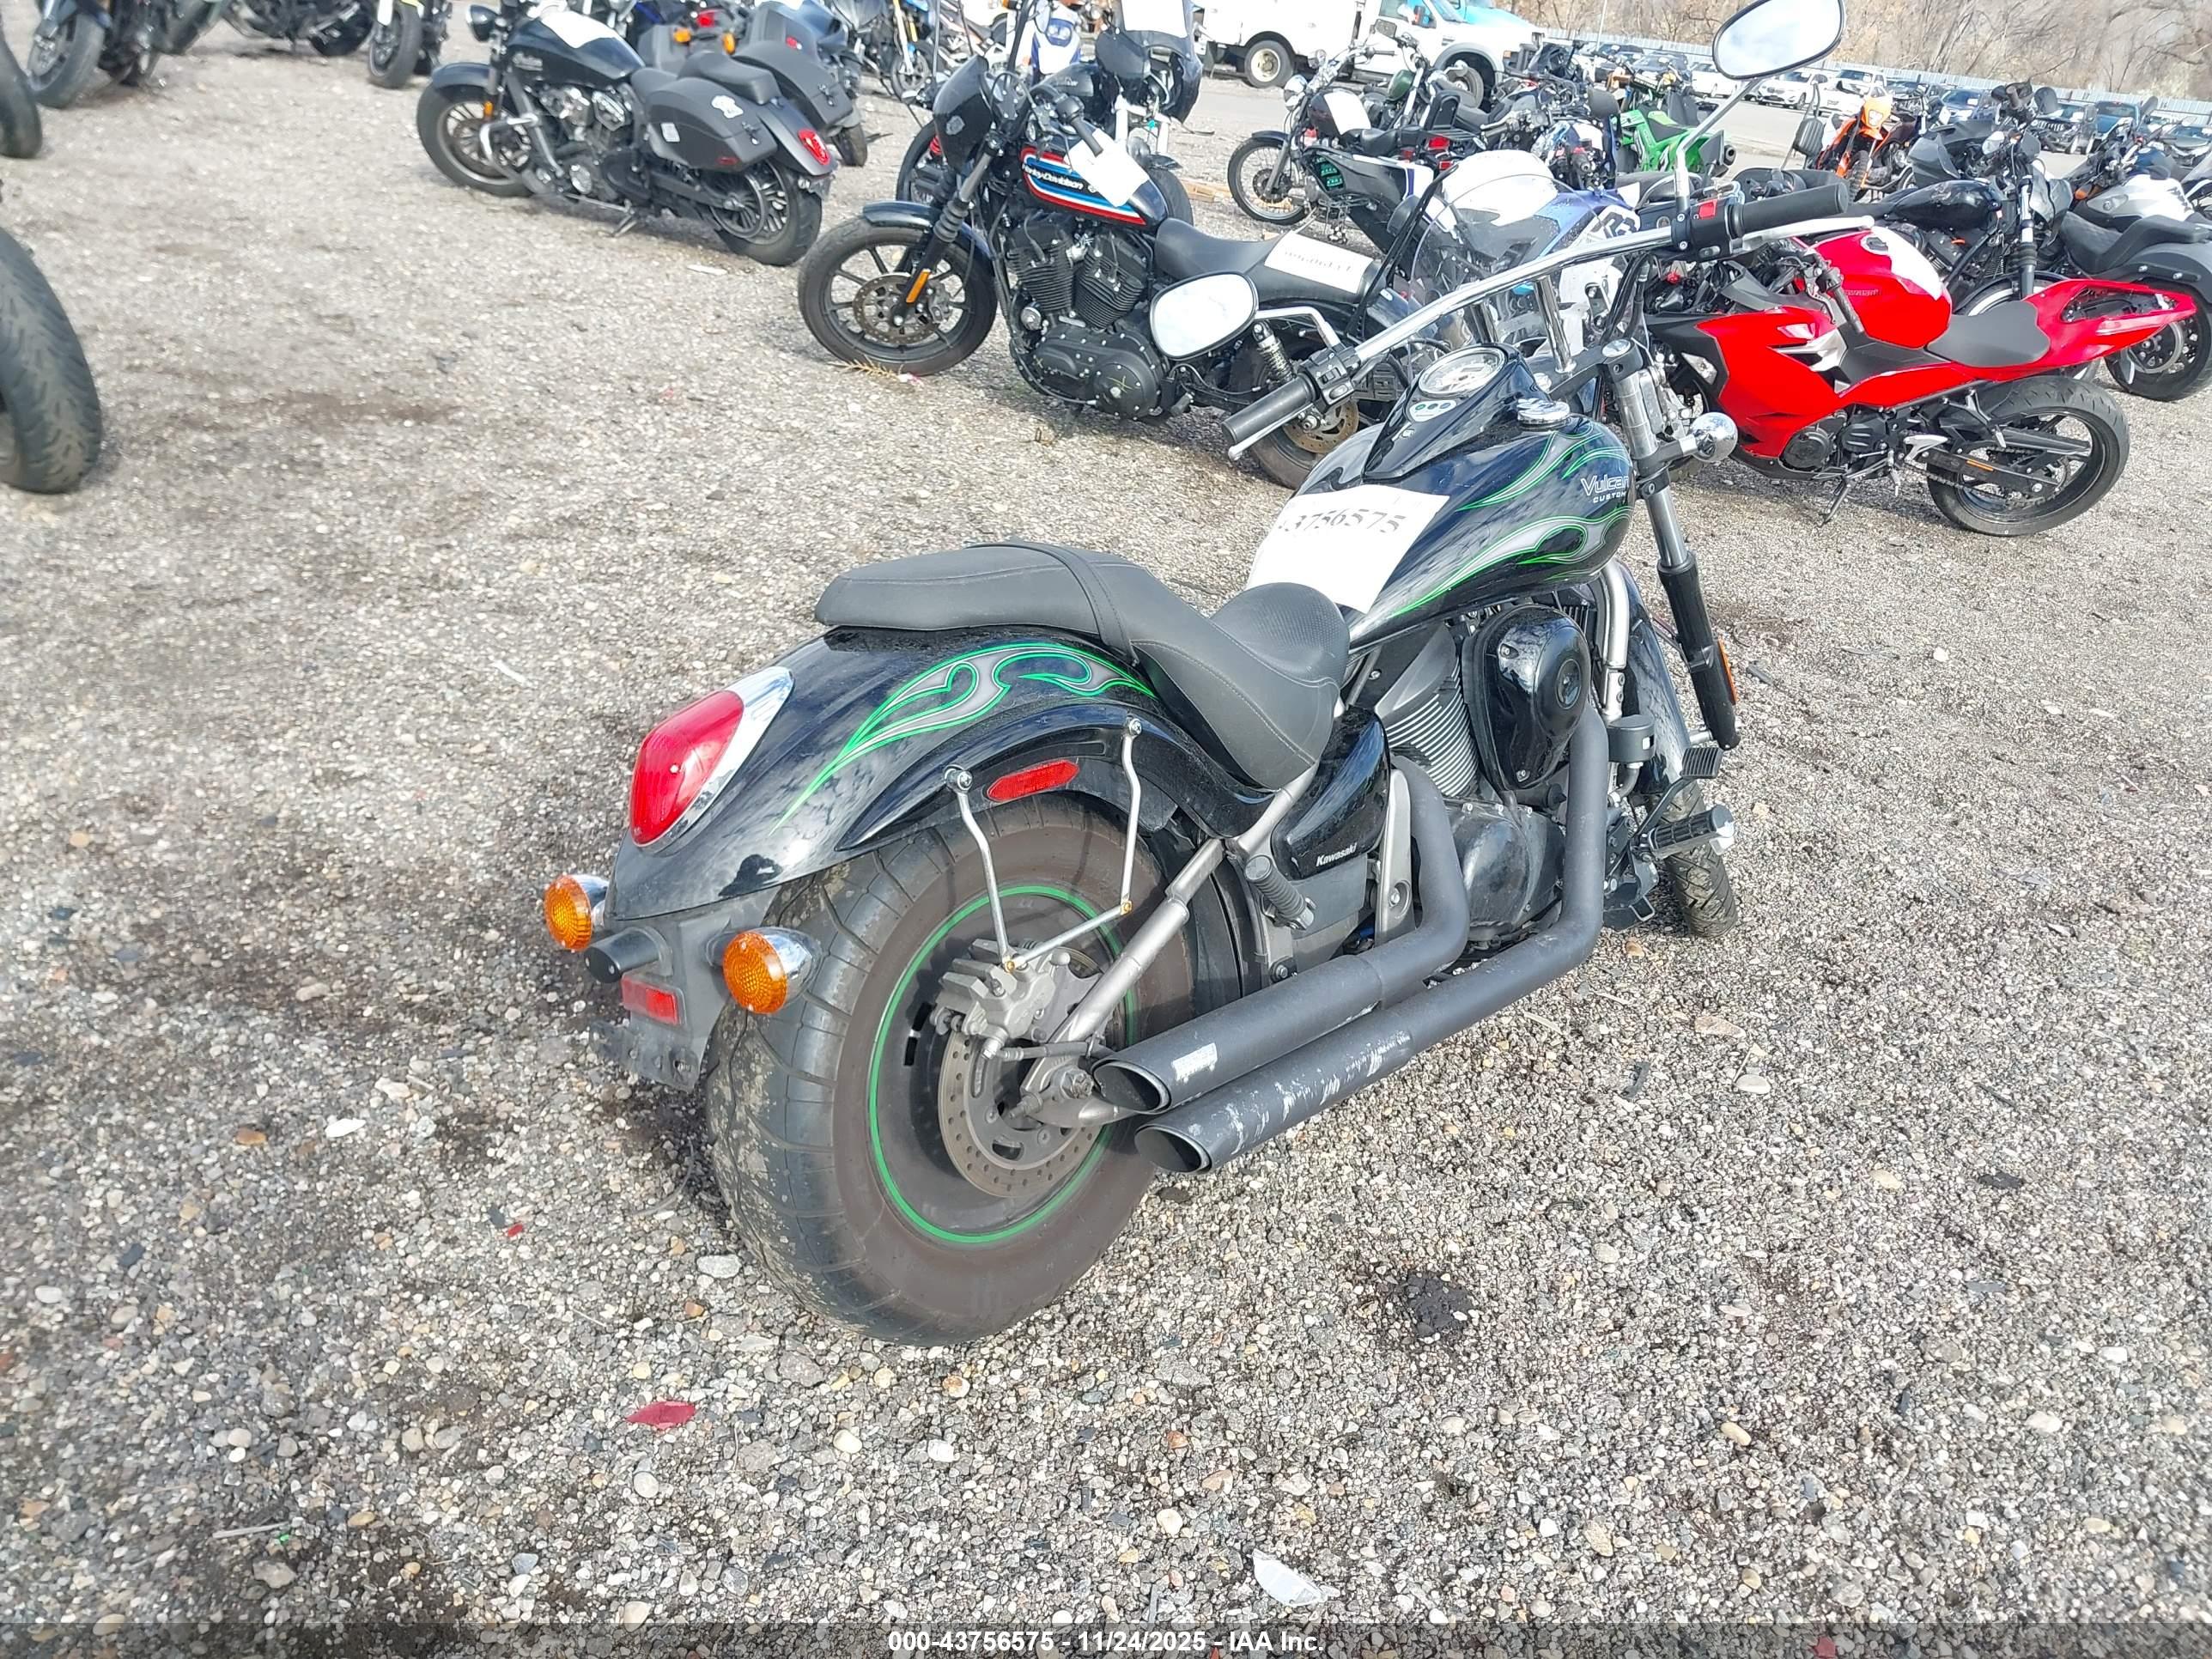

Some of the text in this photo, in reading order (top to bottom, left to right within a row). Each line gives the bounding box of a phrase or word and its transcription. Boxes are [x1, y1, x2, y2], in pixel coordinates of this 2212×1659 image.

[1580, 474, 1630, 496] Vulcan
[1593, 491, 1627, 504] CUSTOM
[1278, 507, 1407, 534] 3756575
[1316, 842, 1358, 867] Kawasaki
